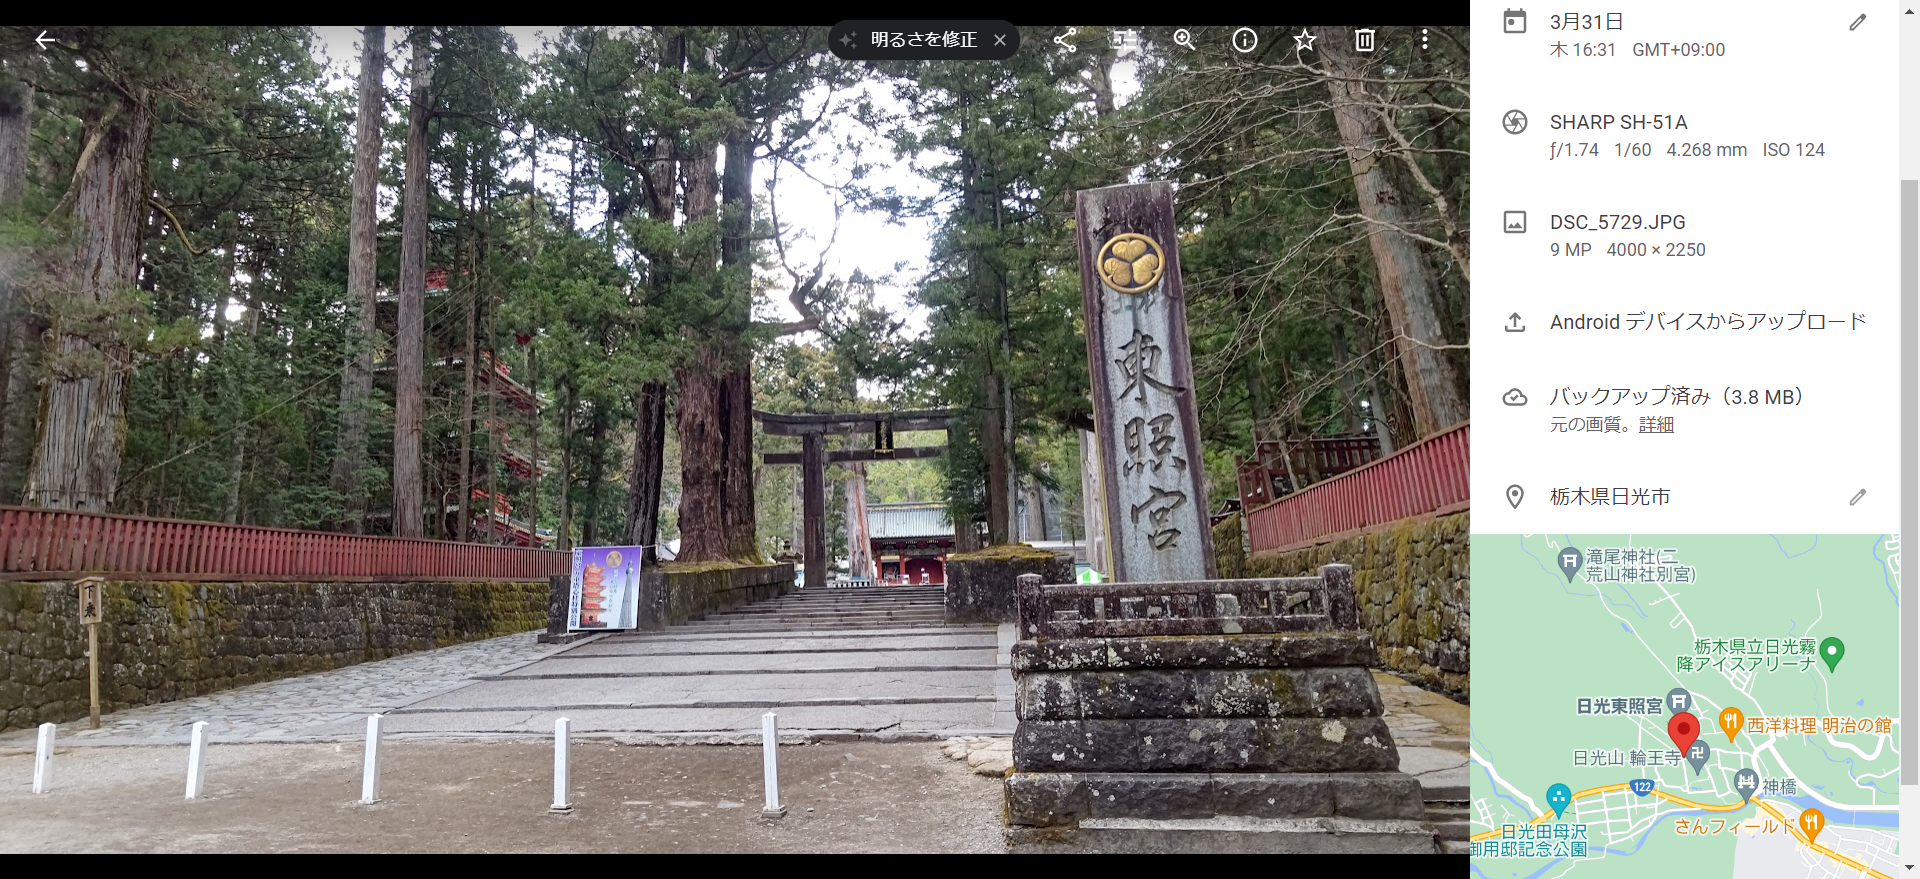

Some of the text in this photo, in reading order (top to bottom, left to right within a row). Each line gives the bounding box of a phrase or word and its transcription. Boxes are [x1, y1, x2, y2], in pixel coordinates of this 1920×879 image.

[1551, 13, 1621, 30] 3月31日
[1550, 41, 1724, 57] 木 16:31 GMT+09:00
[1551, 115, 1687, 129] SHARP SH-51A
[1615, 143, 1651, 157] 1/60
[1667, 143, 1711, 156] 4.268
[1718, 146, 1746, 156] mm
[1764, 143, 1789, 156] ISO
[1797, 143, 1825, 156] 124
[1552, 215, 1684, 231] DSC_5729.JPG
[1551, 243, 1559, 256] 9
[1566, 243, 1591, 256] MP
[1607, 243, 1646, 256] 4000
[1666, 243, 1705, 256] 2250
[1551, 310, 1865, 330] Android デバイスからアップロード
[1115, 329, 1187, 552] 東照宮
[1550, 487, 1670, 505] 栃木県日光市
[1586, 549, 1679, 565] 滝尾神社(二
[1587, 566, 1695, 583] 荒山神社別宮)
[1695, 639, 1815, 654] 栃木県立日光霧
[1678, 656, 1815, 672] 降アイスアリーナ
[1578, 698, 1662, 714] 日光東照宮
[1748, 717, 1891, 733] 西洋料理 明治の館
[1575, 750, 1681, 766] 日光山 輪王寺
[1633, 782, 1651, 793] 122
[1763, 779, 1796, 795] 神橋
[1503, 824, 1587, 840] 日光田母沢
[1675, 818, 1795, 834] さんフィールド
[1471, 841, 1586, 857] 御用邸記念公園
